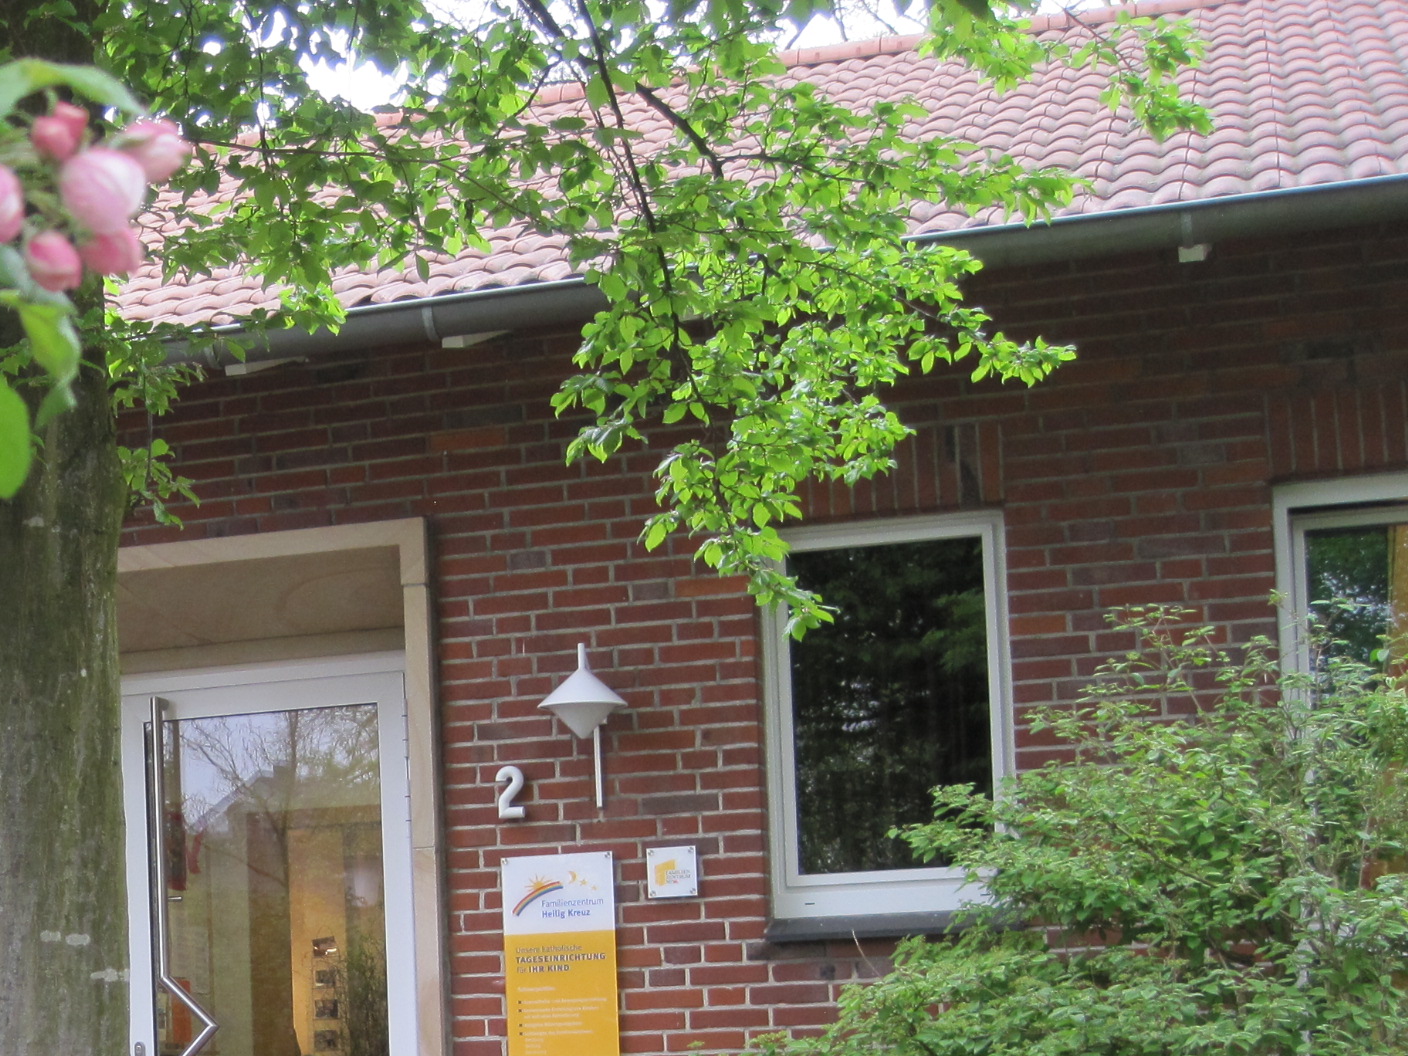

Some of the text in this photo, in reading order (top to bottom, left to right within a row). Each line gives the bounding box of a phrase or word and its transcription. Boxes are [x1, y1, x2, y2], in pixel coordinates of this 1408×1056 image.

[495, 765, 526, 819] 2
[541, 898, 604, 908] Familienzentrum
[542, 909, 590, 919] Heilig Kreuz
[515, 953, 606, 964] TAGESEINRICHTUNG
[529, 965, 545, 973] IHR
[547, 964, 570, 973] KIND
